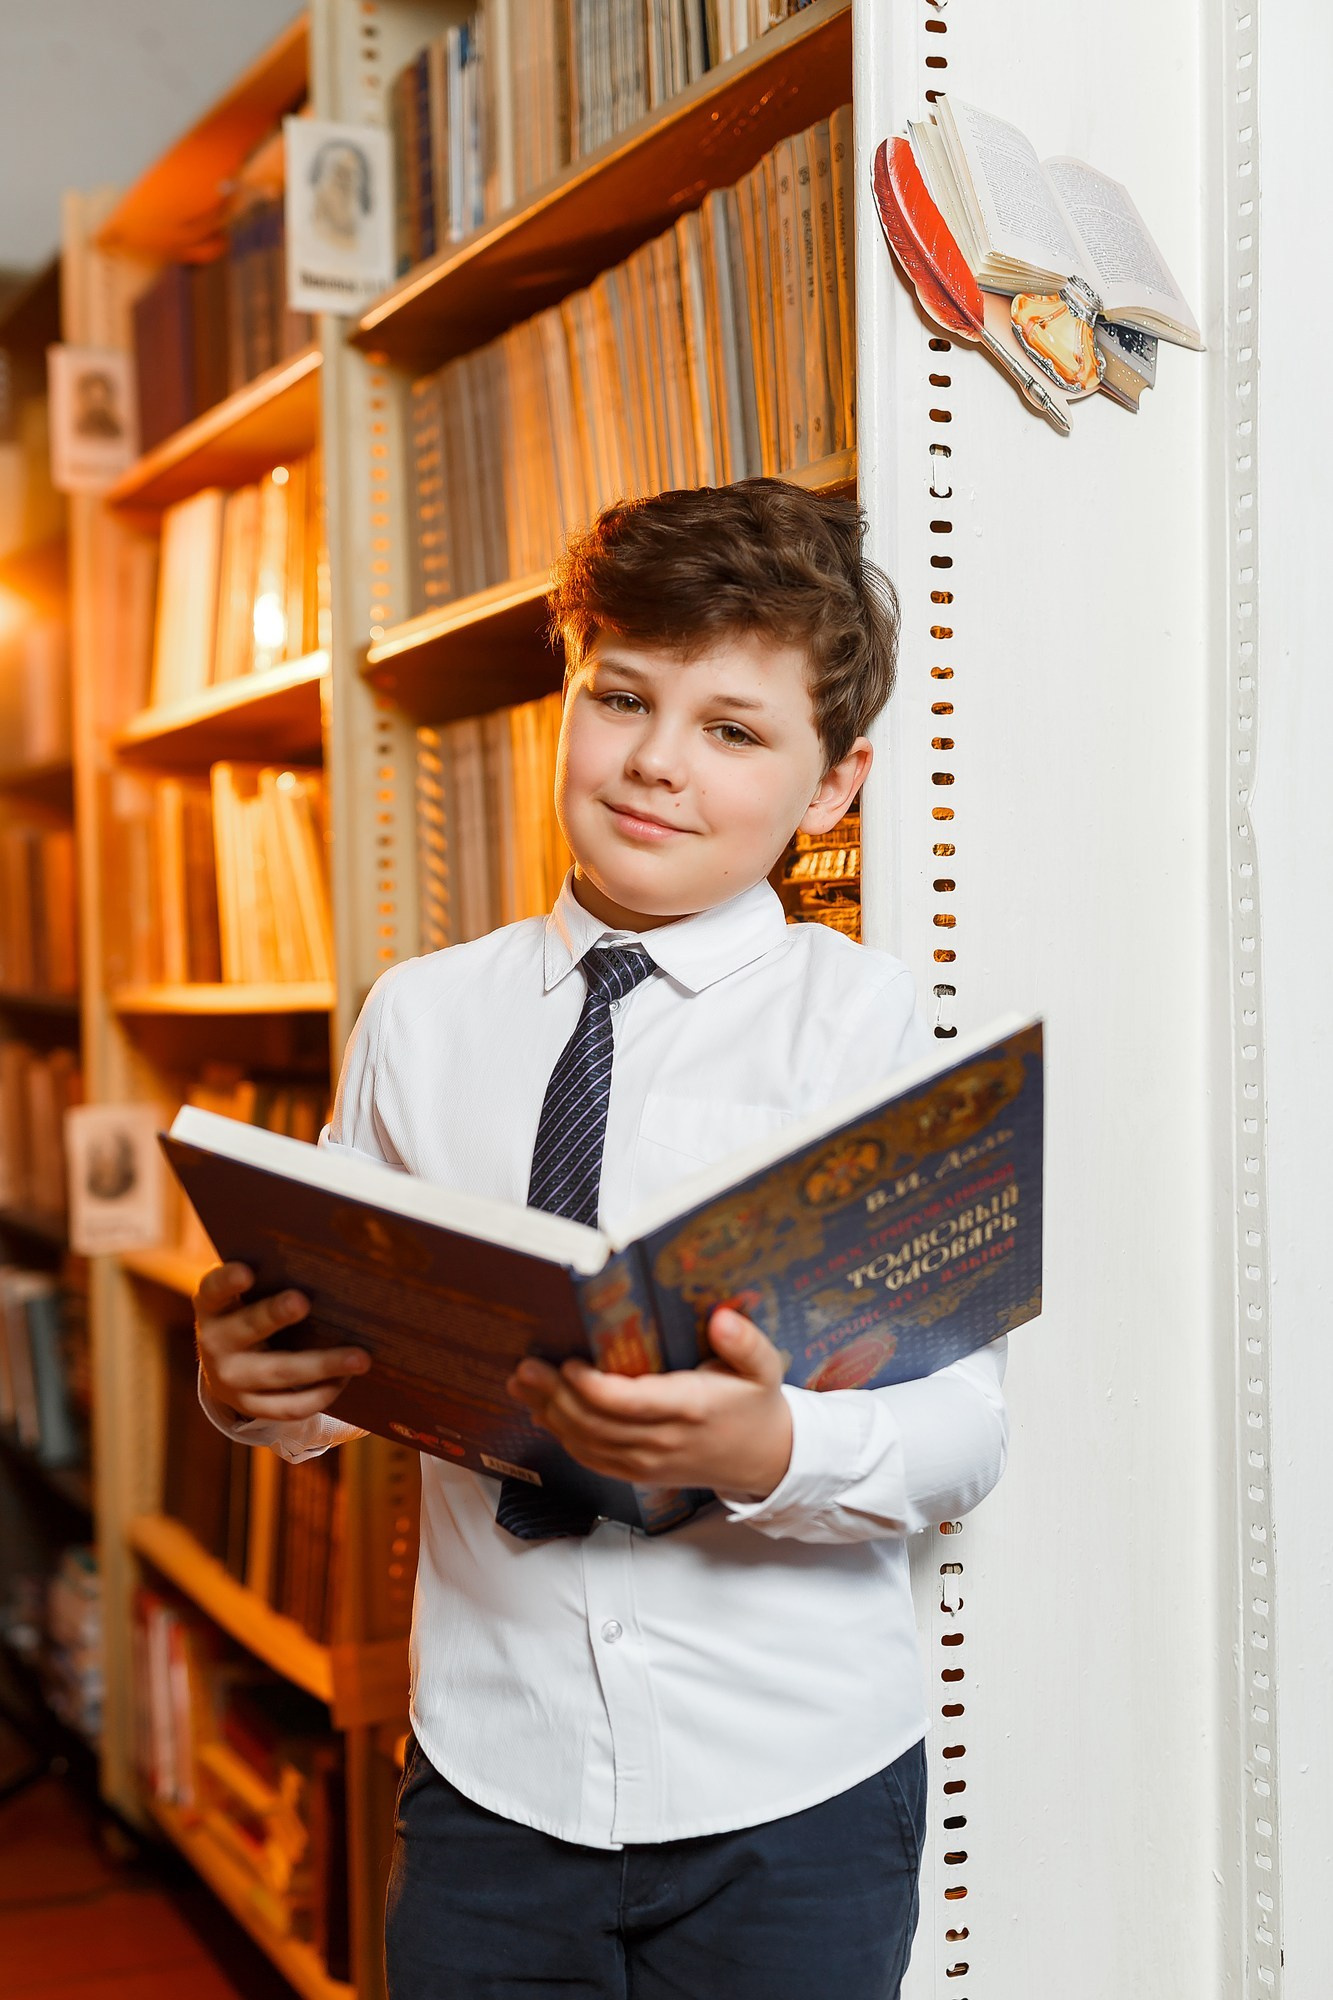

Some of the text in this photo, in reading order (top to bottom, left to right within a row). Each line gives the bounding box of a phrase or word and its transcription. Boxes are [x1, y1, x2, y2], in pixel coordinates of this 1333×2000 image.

[866, 1171, 928, 1213] В.И.
[847, 1182, 1019, 1289] ТОЛКОВЫЙ
[885, 1212, 1018, 1291] СЛОВАРЬ
